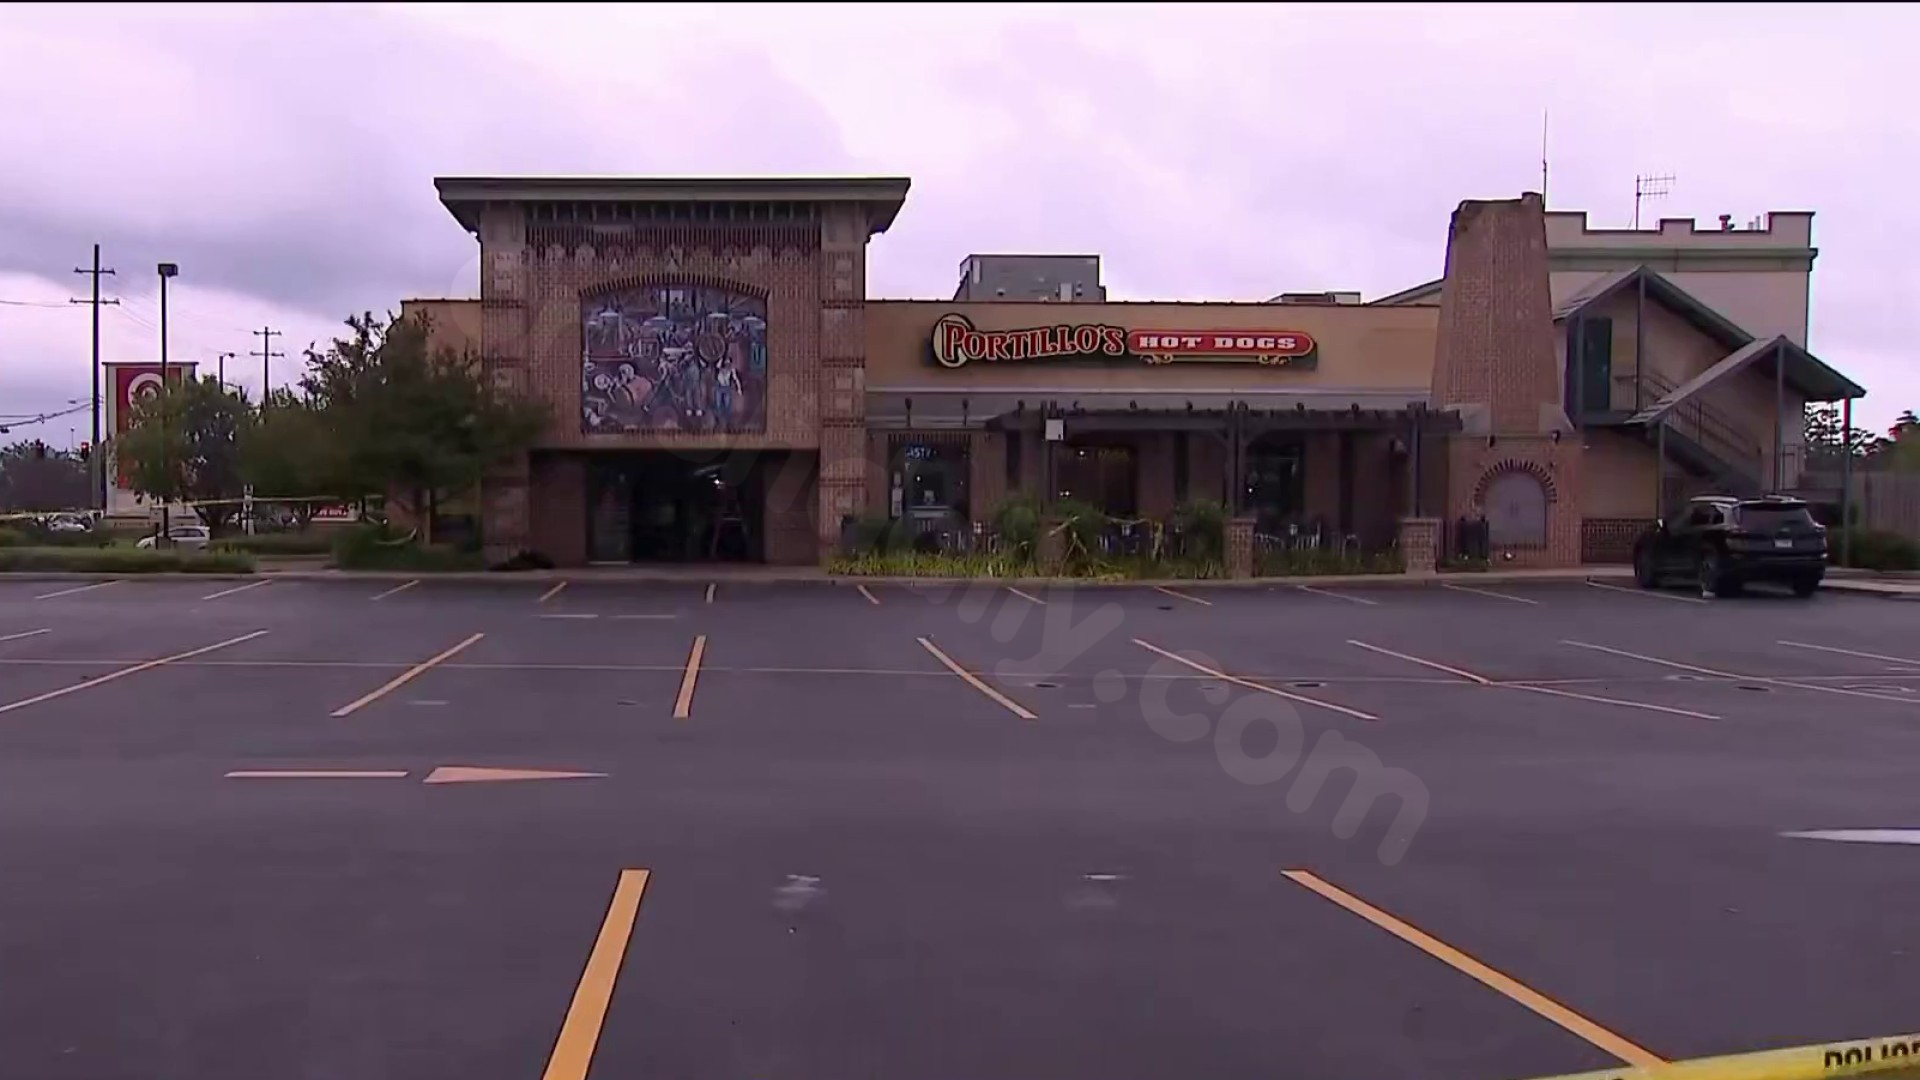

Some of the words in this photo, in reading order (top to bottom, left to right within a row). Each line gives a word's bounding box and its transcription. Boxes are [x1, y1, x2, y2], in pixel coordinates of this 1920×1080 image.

[943, 319, 1125, 360] PORTILLO'S
[1139, 336, 1203, 350] HOT
[1213, 336, 1298, 350] DOGS
